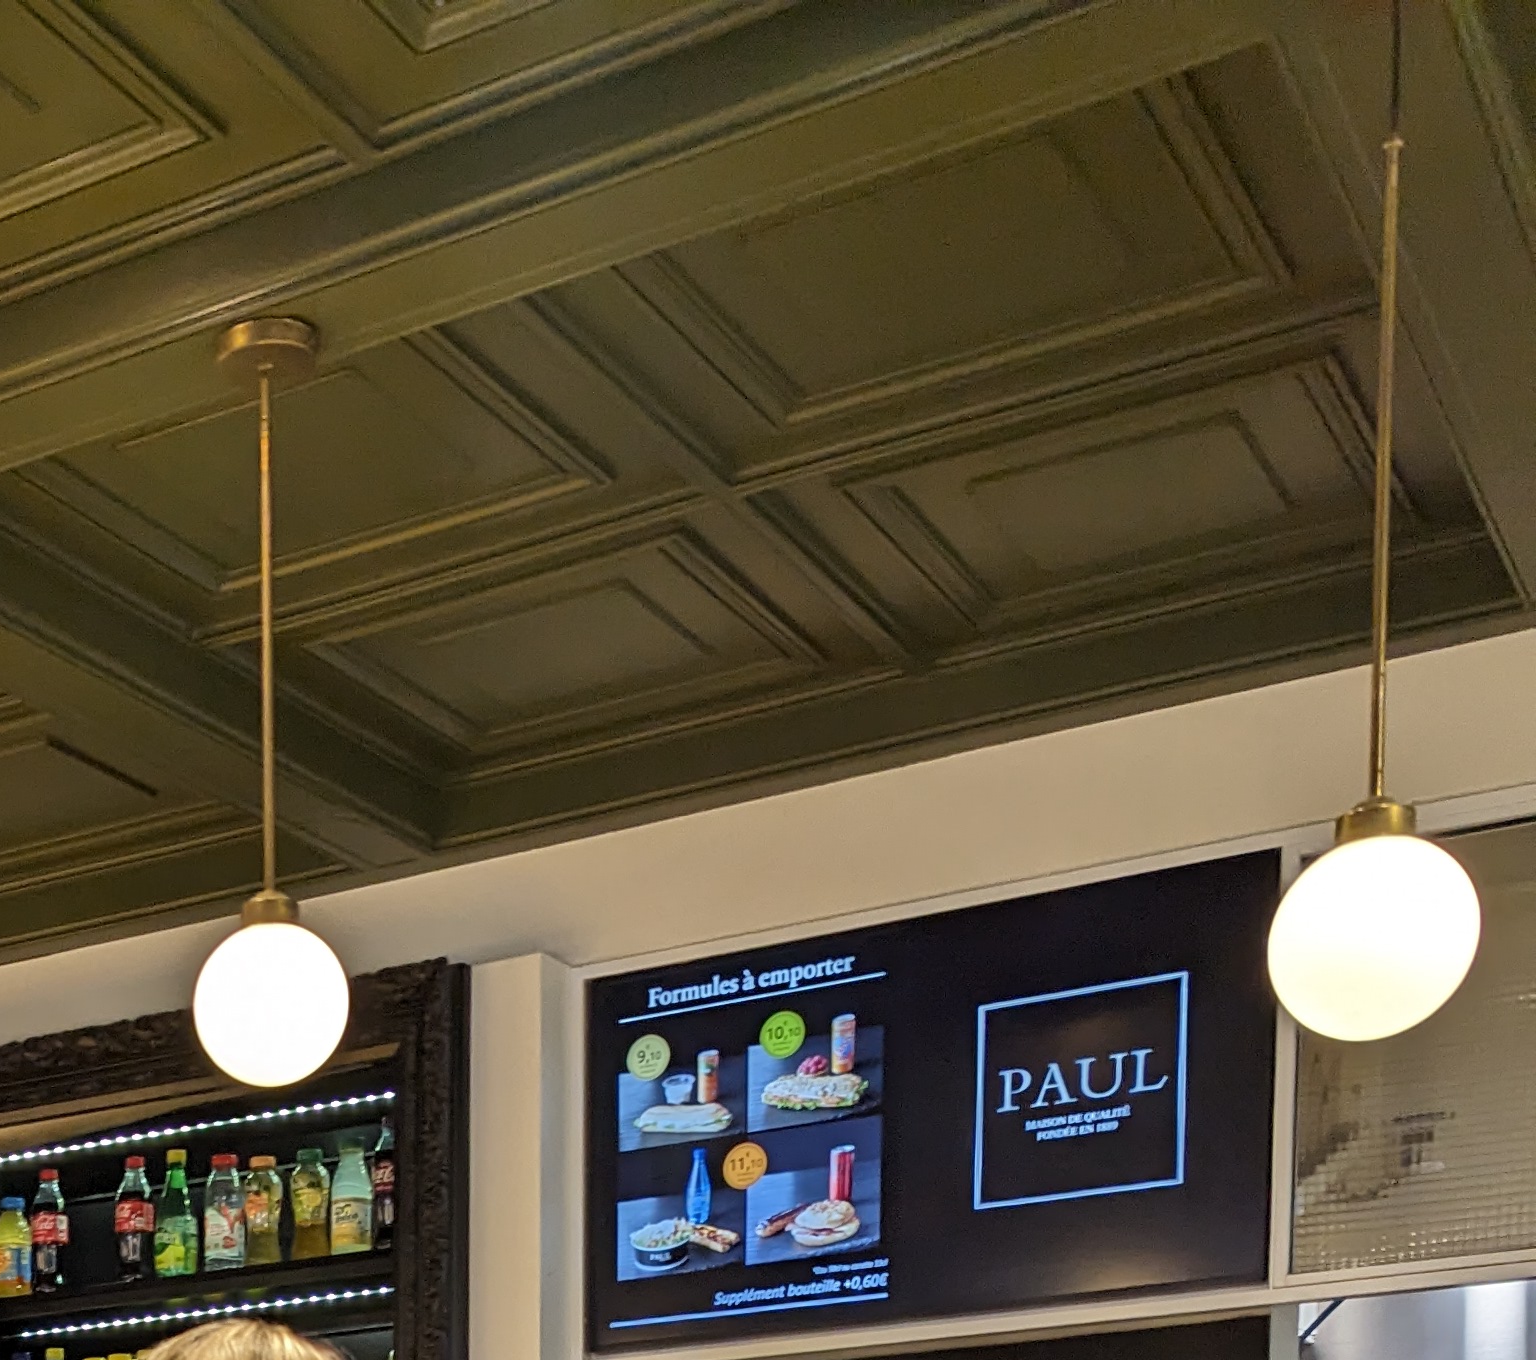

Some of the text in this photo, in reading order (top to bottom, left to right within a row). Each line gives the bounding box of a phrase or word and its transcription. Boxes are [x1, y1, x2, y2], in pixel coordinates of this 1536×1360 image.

[647, 955, 856, 1008] Formules à emporter
[766, 1026, 801, 1042] 10,10
[996, 1048, 1169, 1113] PAUL
[1025, 1104, 1132, 1131] MAISON DE QUALITÉ
[1036, 1124, 1078, 1141] FONDÉE
[1079, 1123, 1095, 1135] EN
[714, 1272, 890, 1306] Supplément bouteille +0,60€
